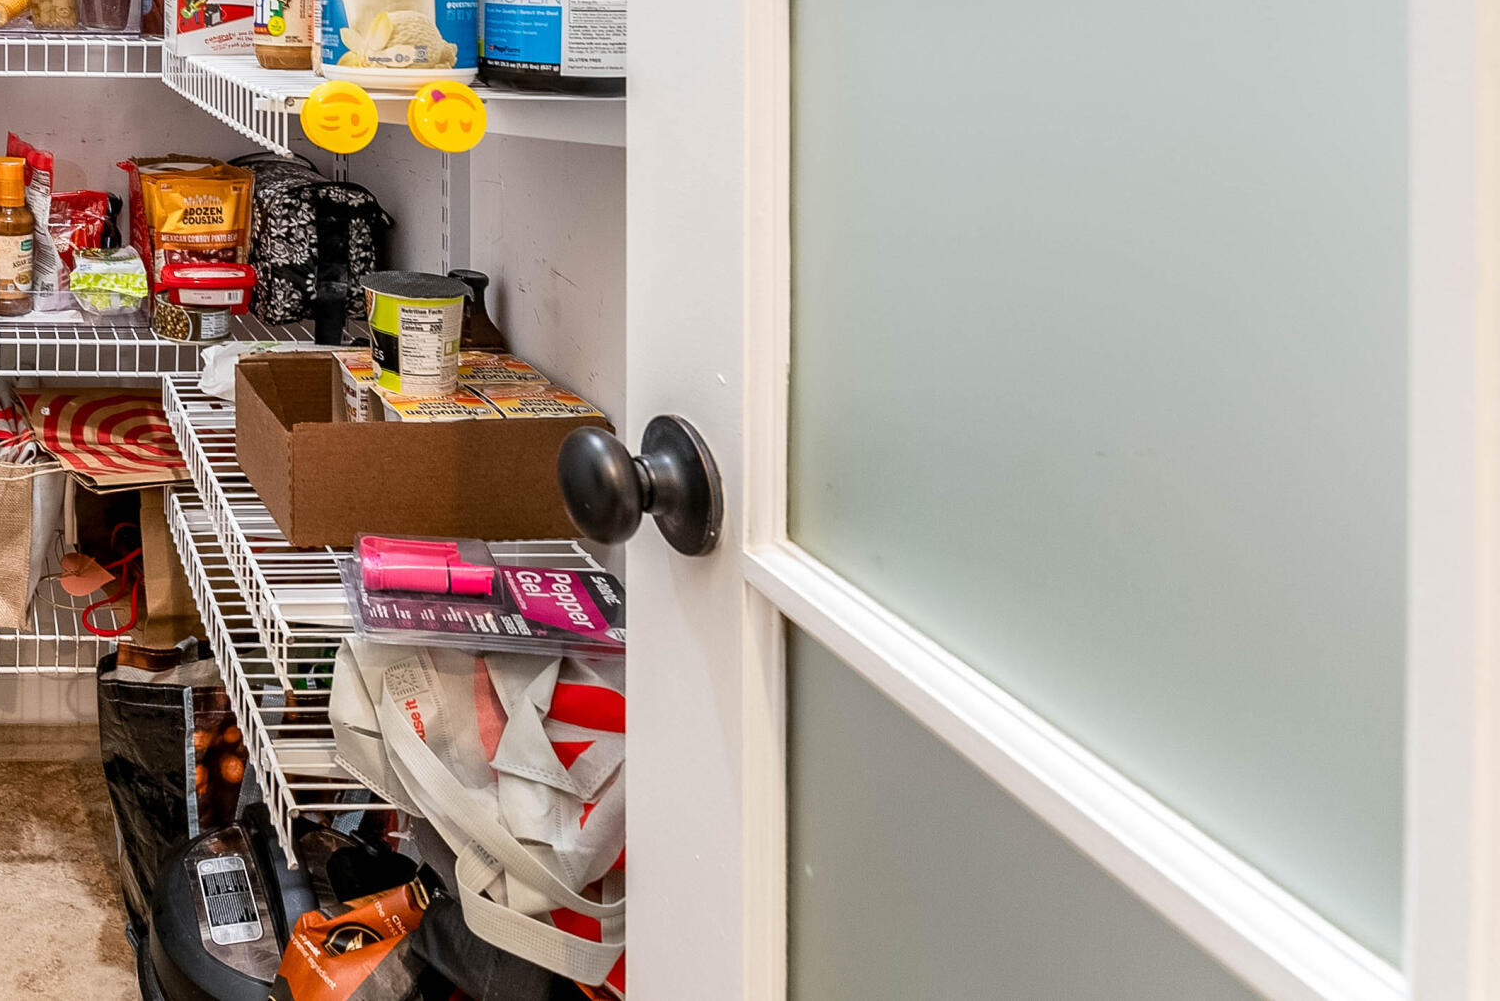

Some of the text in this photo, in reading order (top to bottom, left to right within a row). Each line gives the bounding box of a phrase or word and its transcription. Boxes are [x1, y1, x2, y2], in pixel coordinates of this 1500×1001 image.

[189, 207, 223, 216] DOZEN
[182, 216, 224, 225] COUSINS
[161, 233, 226, 243] MEXICAN COWBOY PINTO
[459, 373, 528, 382] Maruchan
[405, 408, 480, 418] Maruchan
[507, 406, 581, 416] Maruchan
[516, 571, 551, 597] Gel
[544, 572, 595, 629] Pepper
[405, 698, 418, 711] it
